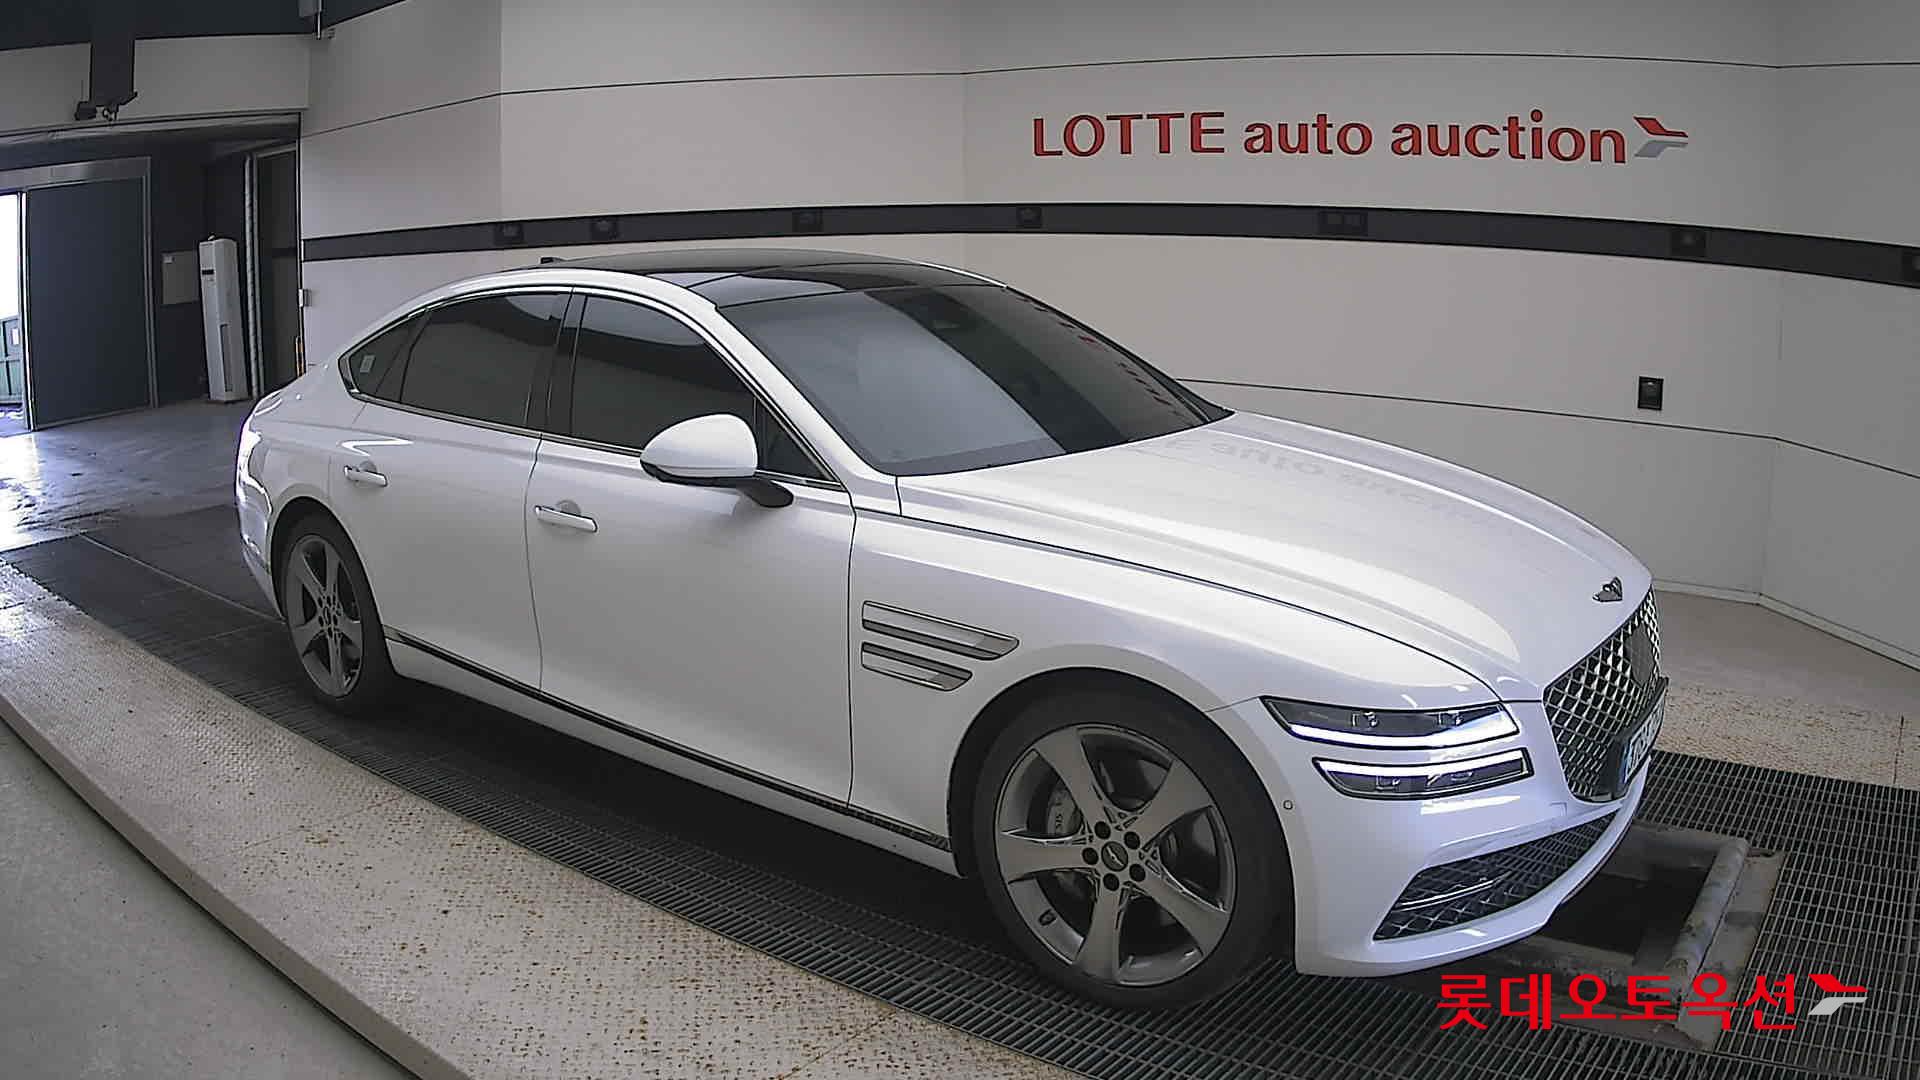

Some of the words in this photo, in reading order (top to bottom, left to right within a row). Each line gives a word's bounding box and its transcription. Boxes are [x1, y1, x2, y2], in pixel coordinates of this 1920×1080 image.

[1033, 112, 1226, 158] LOTTE
[1243, 113, 1373, 155] auto
[1389, 108, 1627, 164] auction
